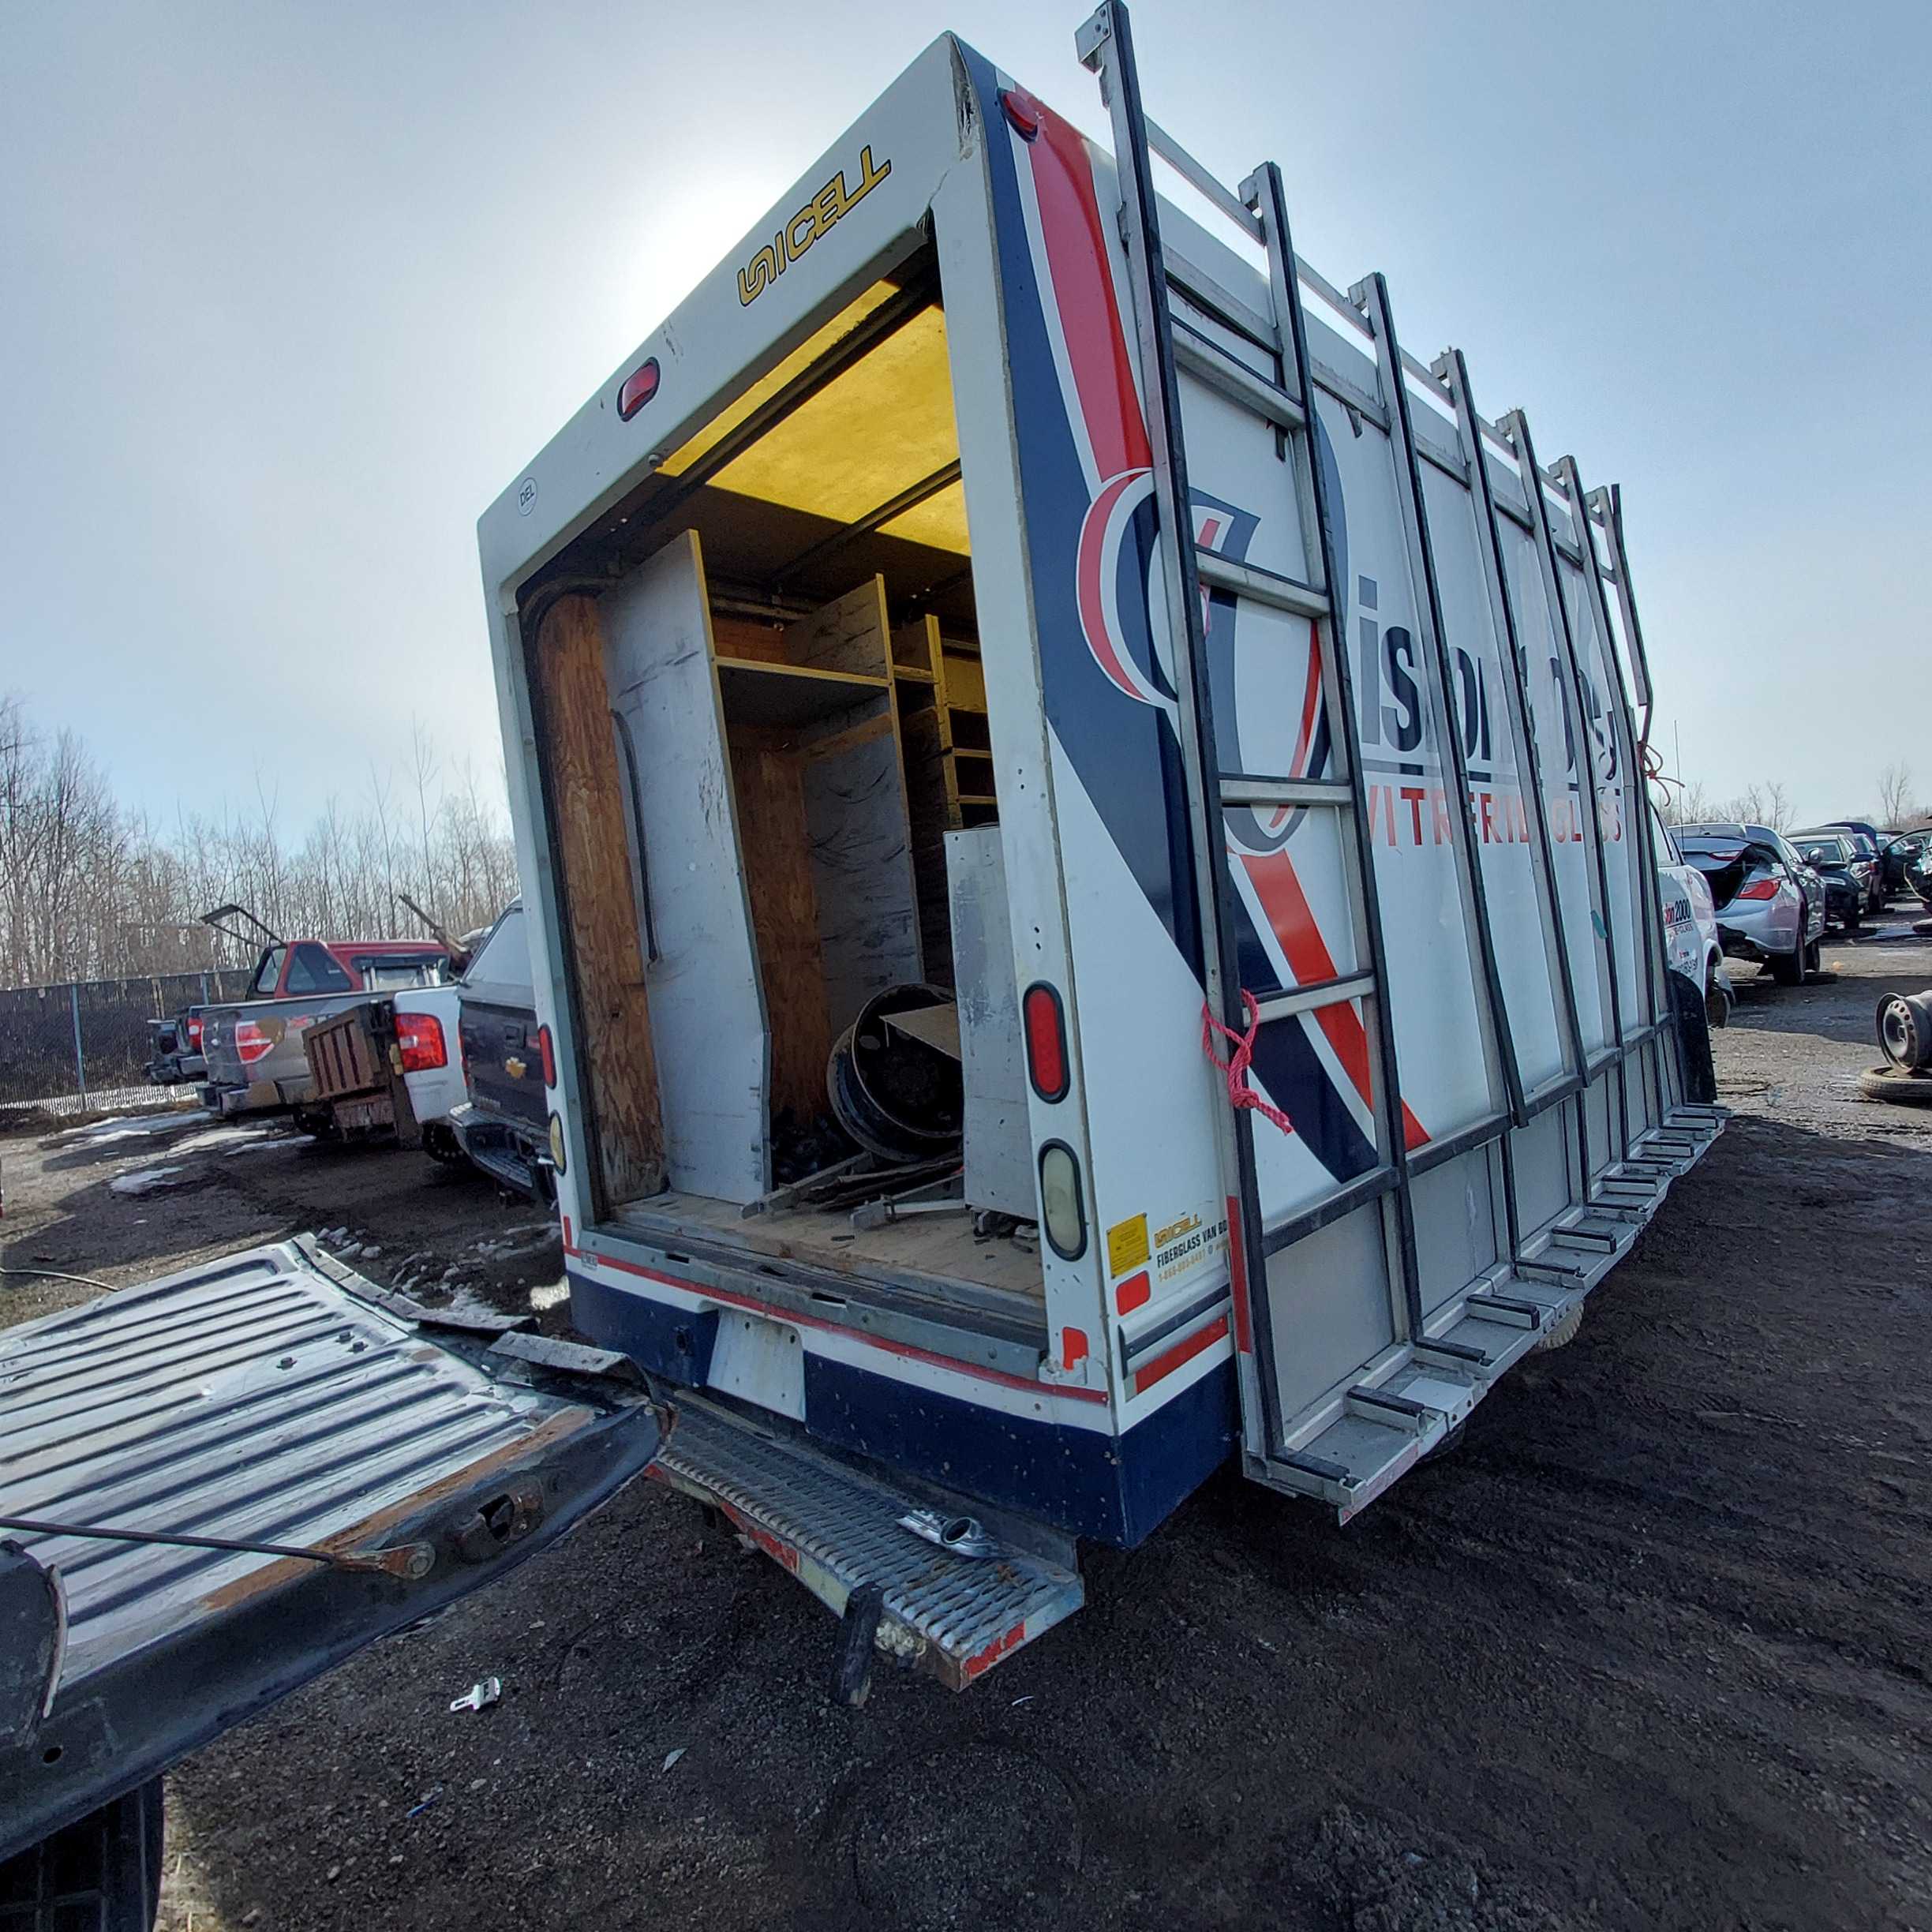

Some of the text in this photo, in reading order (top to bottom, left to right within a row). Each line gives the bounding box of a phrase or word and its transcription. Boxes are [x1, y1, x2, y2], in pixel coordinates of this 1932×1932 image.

[737, 144, 891, 307] UNICELL
[1675, 898, 1691, 923] 2000
[1157, 1234, 1201, 1268] FIBERGLASS
[1202, 1225, 1217, 1243] VAN
